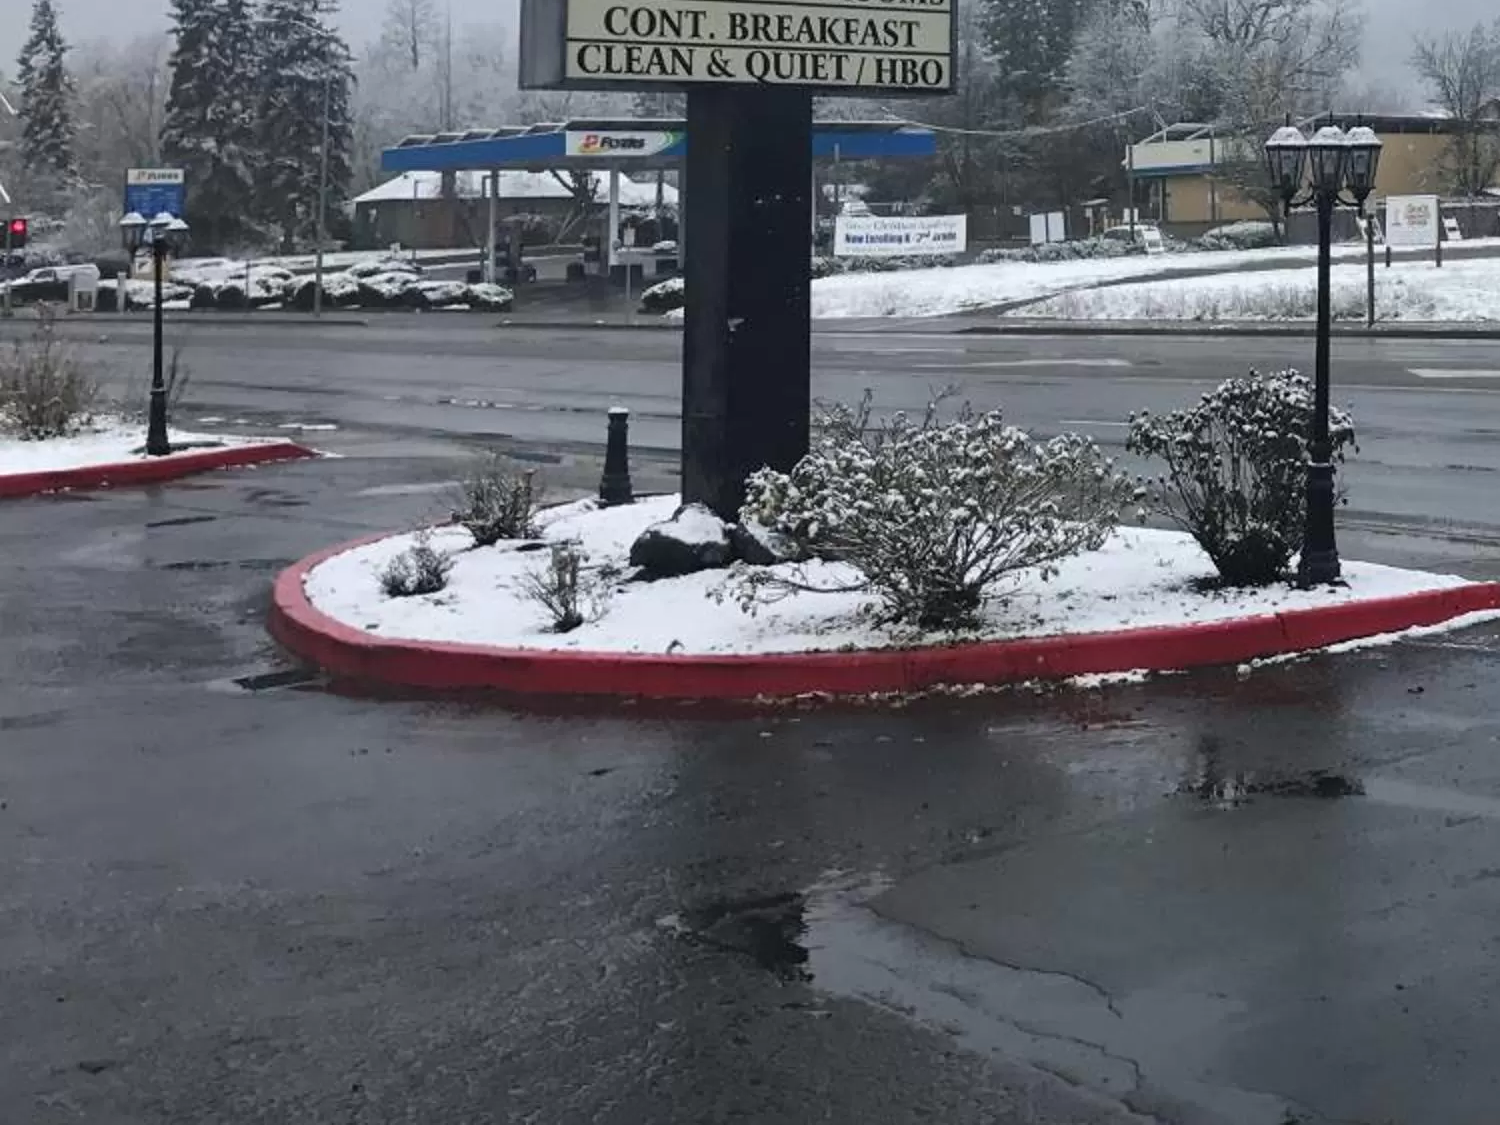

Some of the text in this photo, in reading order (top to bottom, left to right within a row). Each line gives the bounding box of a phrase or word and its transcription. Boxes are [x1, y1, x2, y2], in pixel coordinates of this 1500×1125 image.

[604, 5, 920, 47] CONT. BREAKFAST
[577, 44, 694, 76] CLEAN
[707, 49, 735, 78] &
